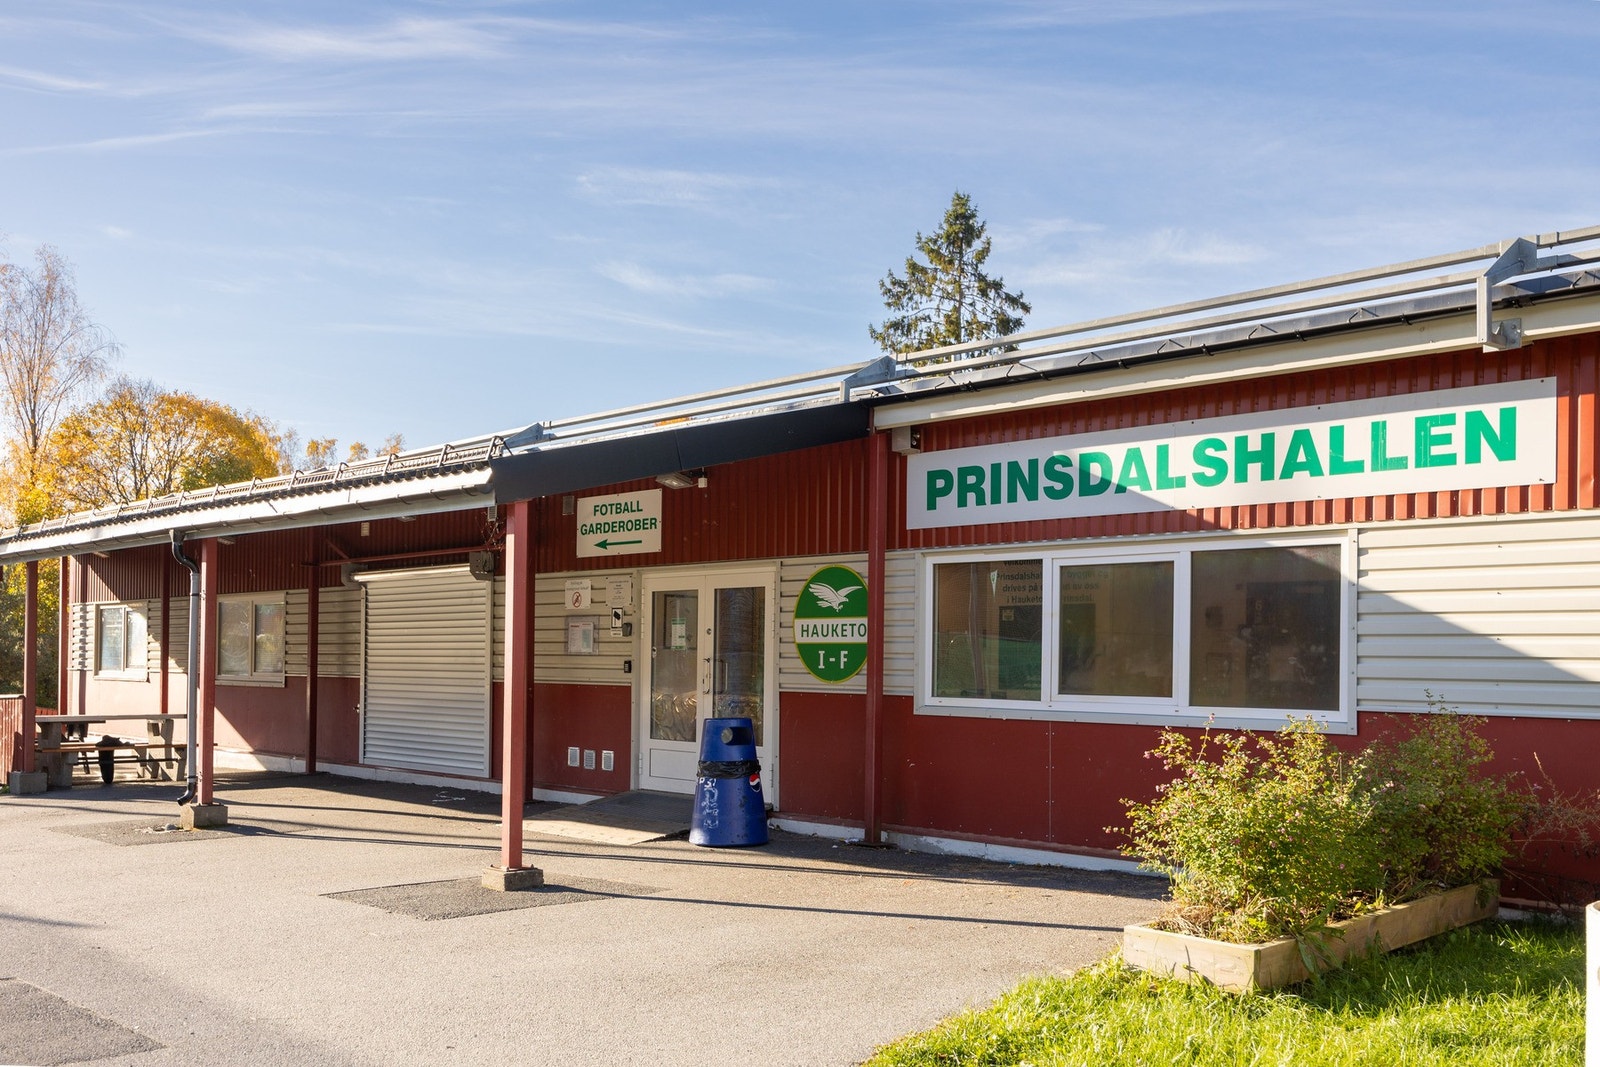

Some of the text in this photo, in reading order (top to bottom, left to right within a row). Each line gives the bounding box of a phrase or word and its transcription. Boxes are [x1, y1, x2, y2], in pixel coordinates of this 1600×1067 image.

[926, 407, 1517, 511] PRINSDALSHALLEN
[593, 500, 643, 517] FOTBALL
[580, 517, 658, 536] GARDEROBER
[800, 622, 867, 638] HAUKETO
